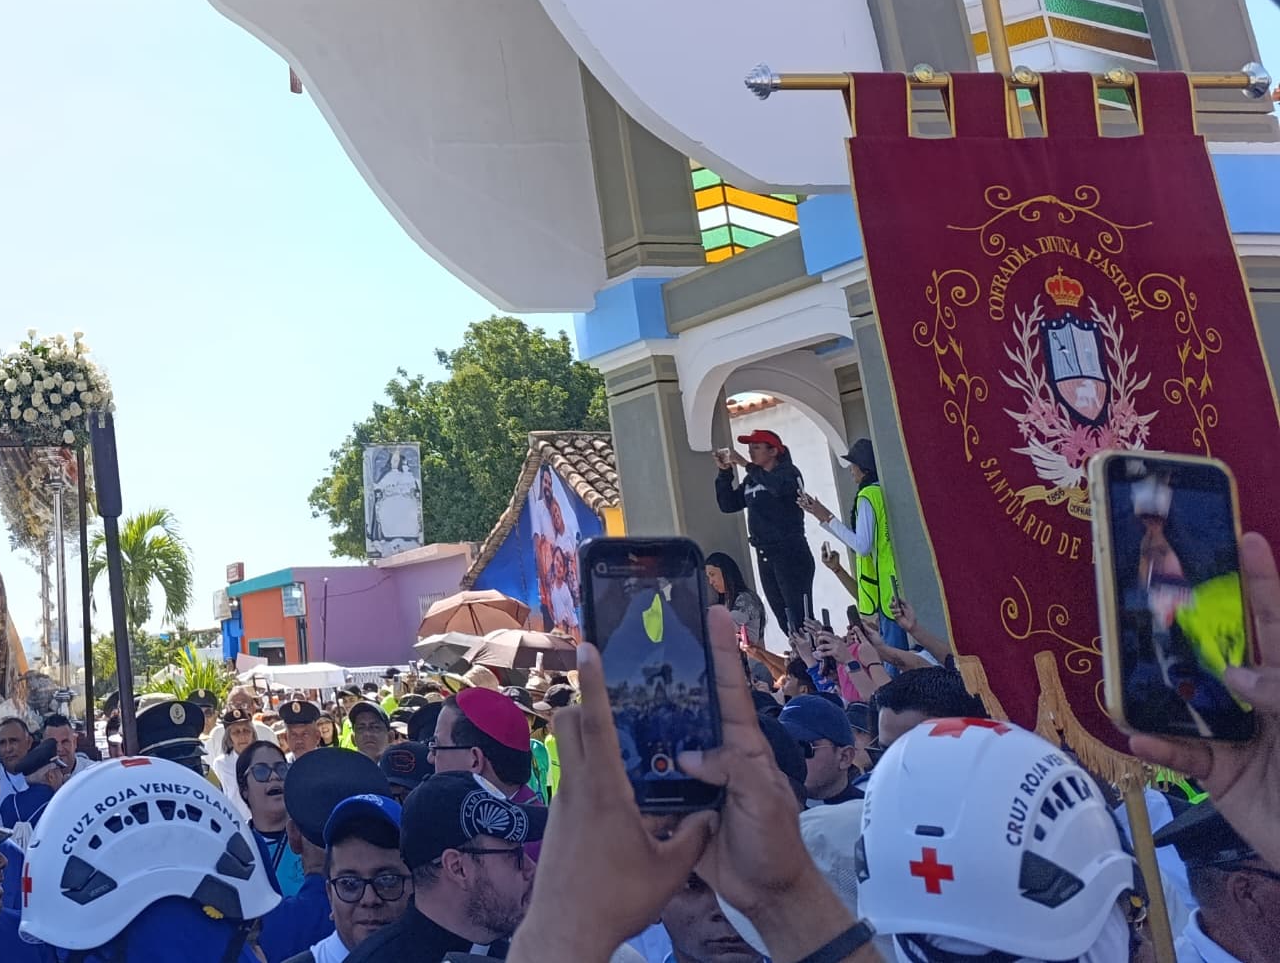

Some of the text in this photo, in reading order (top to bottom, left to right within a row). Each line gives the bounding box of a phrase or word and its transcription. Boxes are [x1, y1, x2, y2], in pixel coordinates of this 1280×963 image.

[1036, 236, 1082, 259] DIVINA
[1083, 248, 1144, 321] PASTORA
[980, 457, 1081, 559] SANTUARIO DE
[62, 811, 97, 855] CRUZ
[94, 787, 138, 815] ROJA
